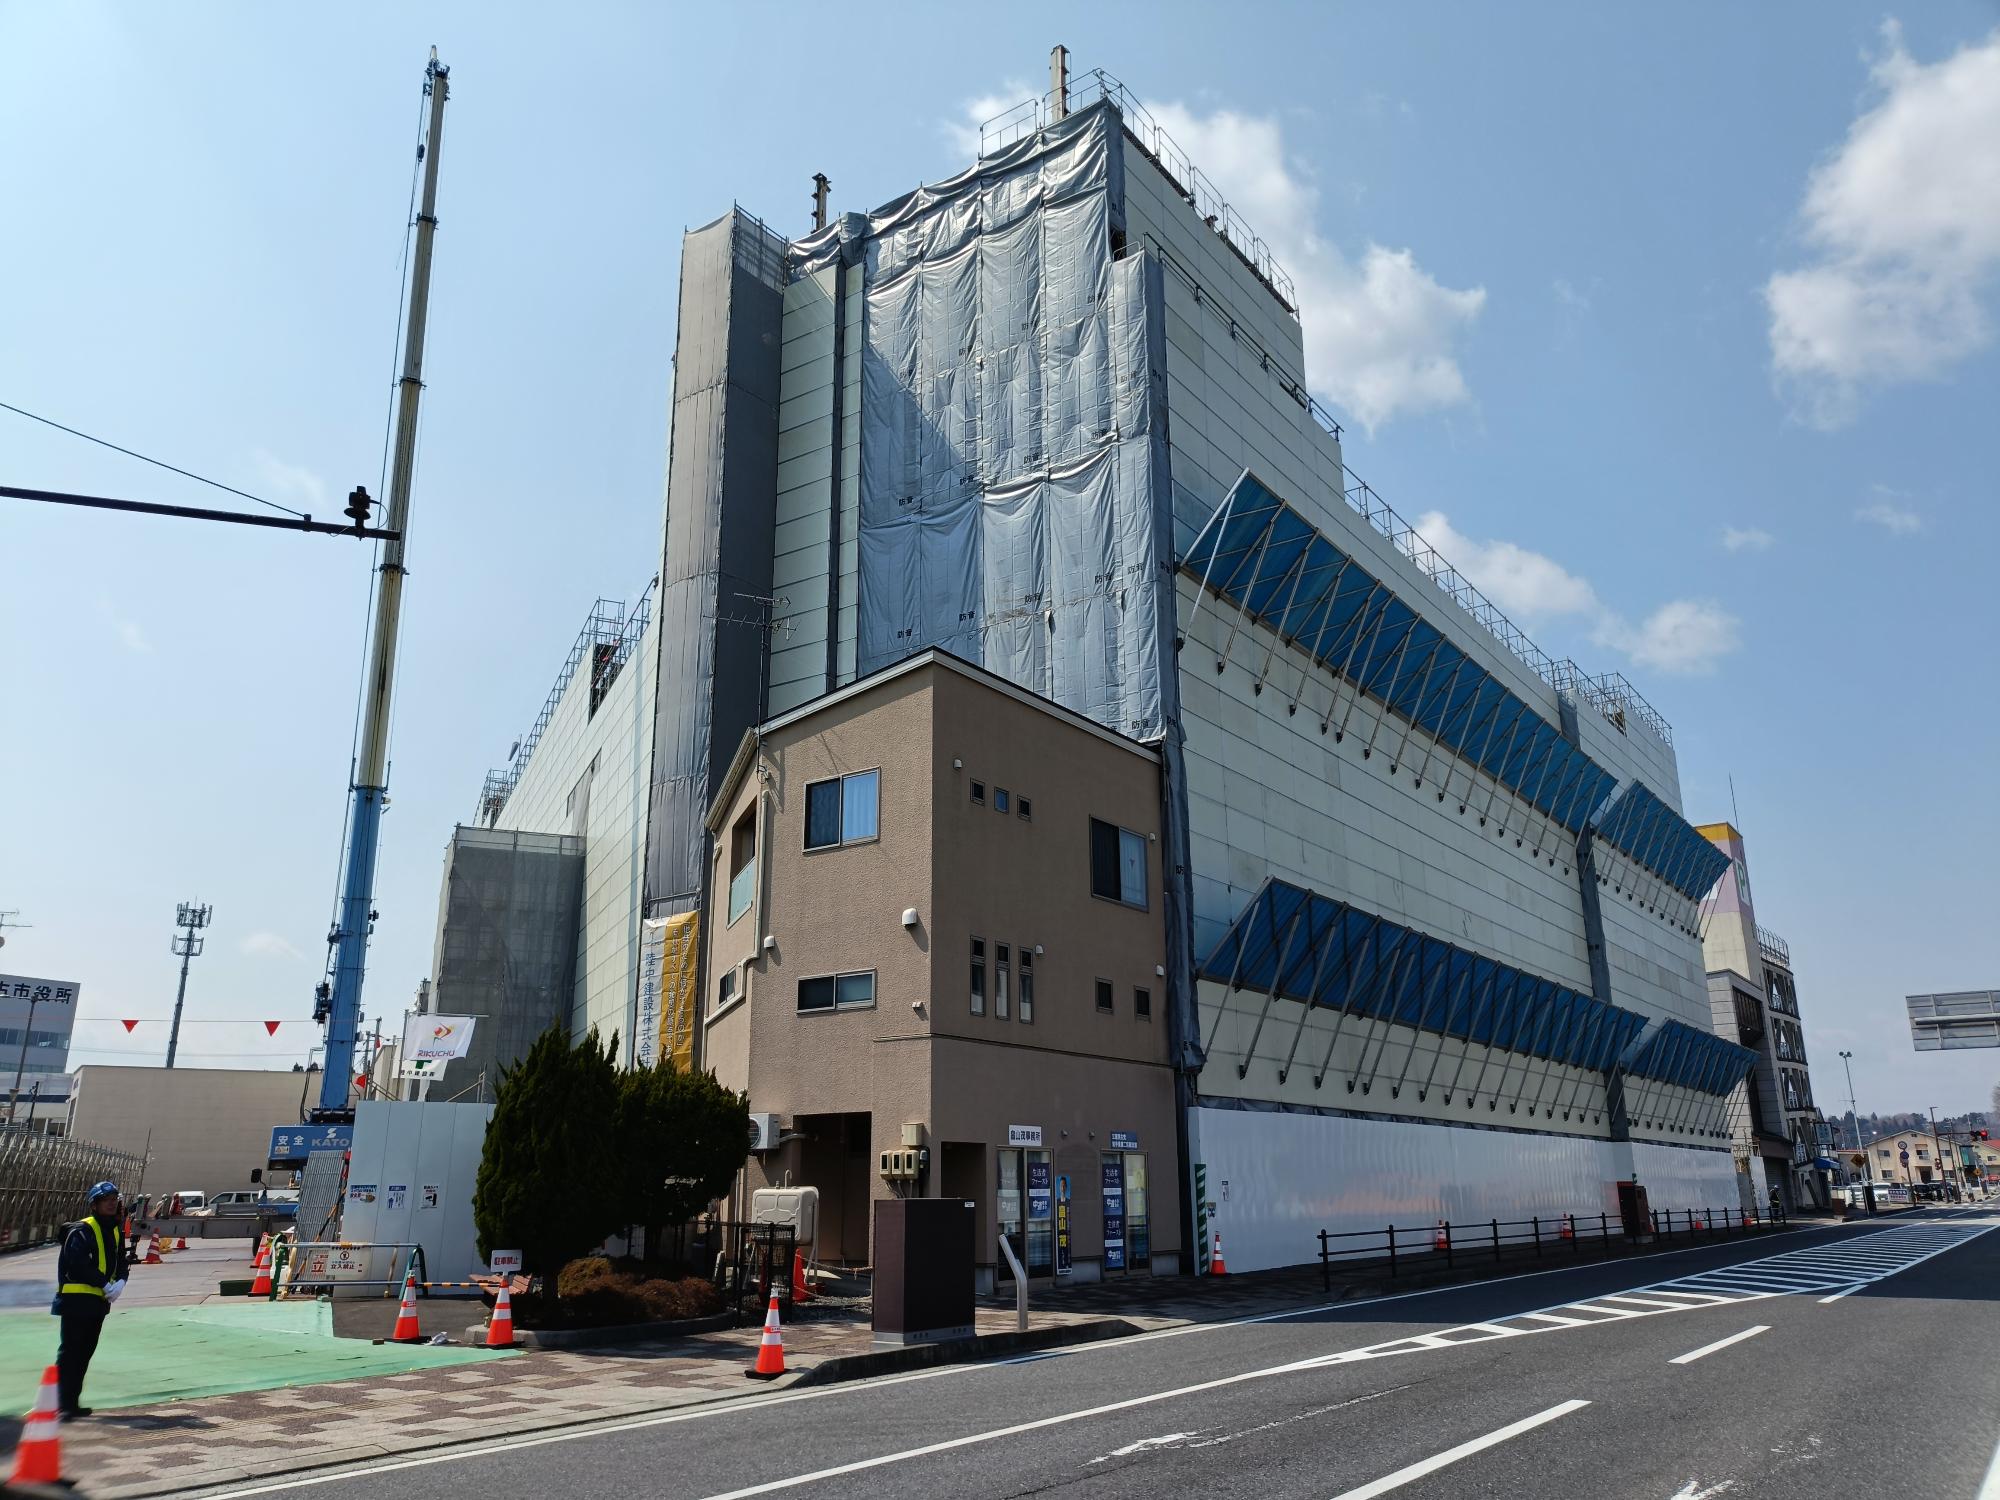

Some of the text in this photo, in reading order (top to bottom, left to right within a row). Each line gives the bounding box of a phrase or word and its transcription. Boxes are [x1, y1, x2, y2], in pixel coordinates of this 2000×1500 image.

[1023, 452, 1039, 464] 防音
[959, 474, 975, 486] 防音
[898, 496, 914, 507] 防音
[959, 610, 976, 622] 防音
[897, 628, 912, 639] 防音
[1131, 719, 1149, 730] 防音
[1737, 862, 1746, 899] P
[417, 1049, 455, 1058] RIKUCHU
[278, 1135, 304, 1146] 安全
[311, 1138, 350, 1147] KATO
[494, 1256, 519, 1266] 駐車禁止
